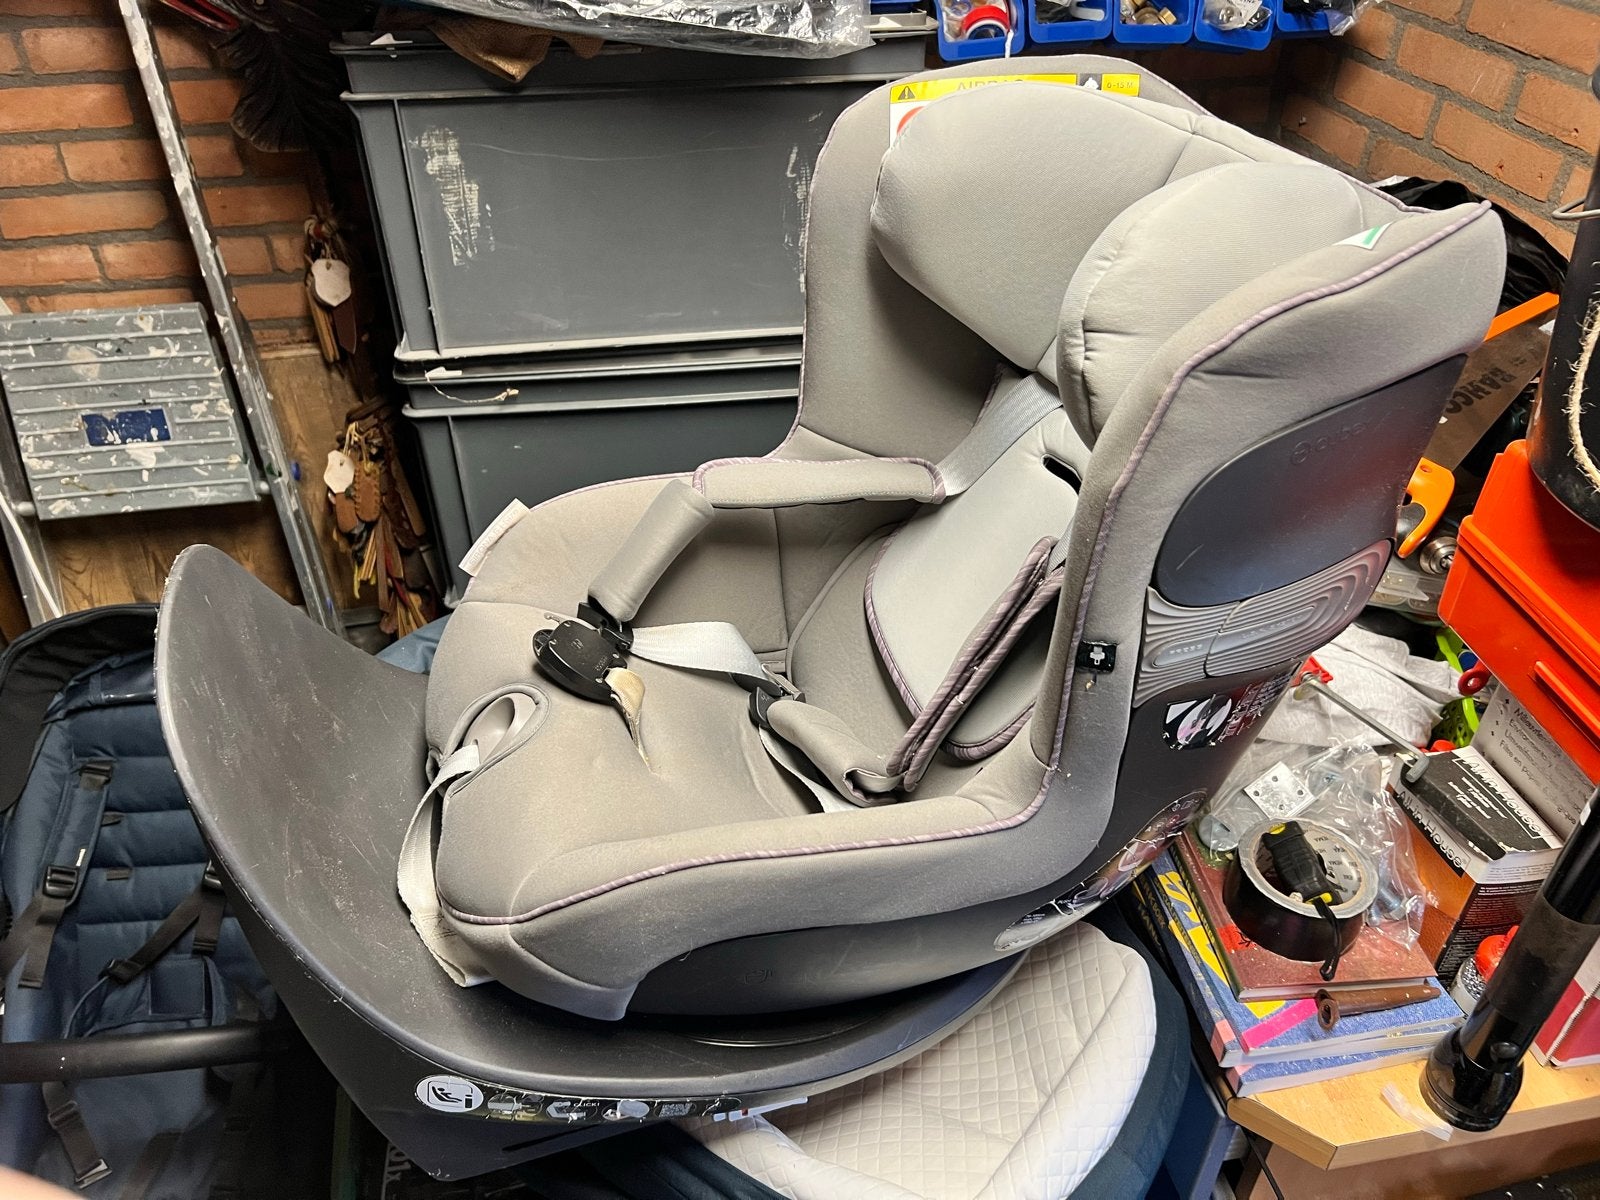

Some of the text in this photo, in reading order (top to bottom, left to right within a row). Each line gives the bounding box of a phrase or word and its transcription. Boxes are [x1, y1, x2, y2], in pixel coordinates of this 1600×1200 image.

[1395, 789, 1467, 869] All in House
[1494, 786, 1543, 834] House
